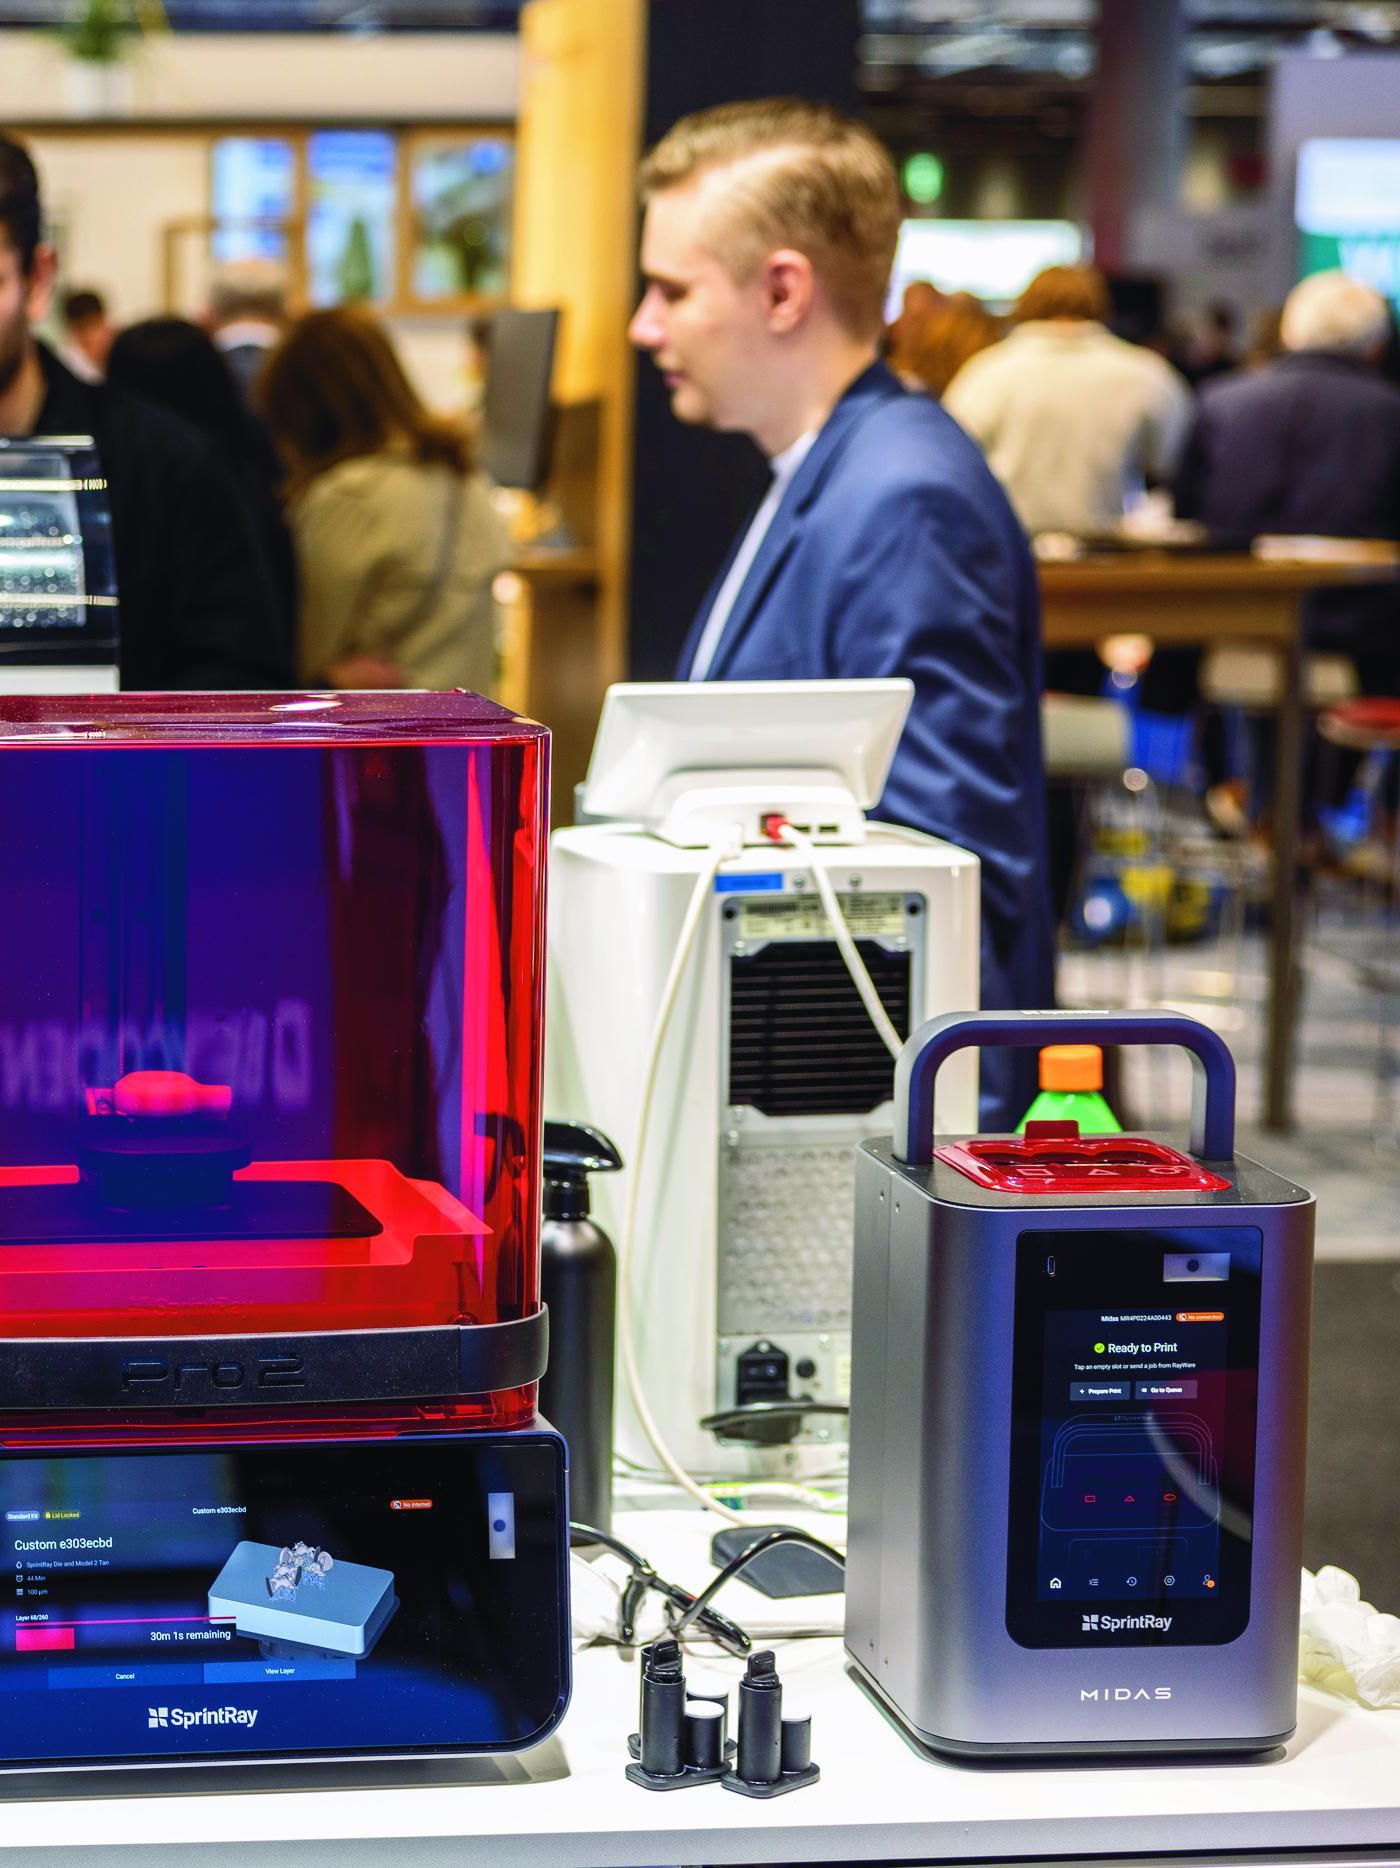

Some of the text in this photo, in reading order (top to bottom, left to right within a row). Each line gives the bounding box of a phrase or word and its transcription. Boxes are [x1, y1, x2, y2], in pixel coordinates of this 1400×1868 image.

[1108, 1342, 1178, 1355] Ready to Print
[1172, 1362, 1196, 1370] RayWare
[1088, 1387, 1122, 1396] Prepare Print
[60, 1511, 80, 1519] Locked
[192, 1506, 247, 1515] Custom e303ecbd
[14, 1537, 113, 1551] Custom e303ecbd
[1100, 1614, 1173, 1633] SprintRay
[150, 1629, 232, 1642] 30m 1s remaining
[115, 1672, 135, 1680] Cancel
[279, 1667, 296, 1676] Layer
[1080, 1687, 1172, 1701] MIDAS
[170, 1706, 259, 1729] SprintRay
